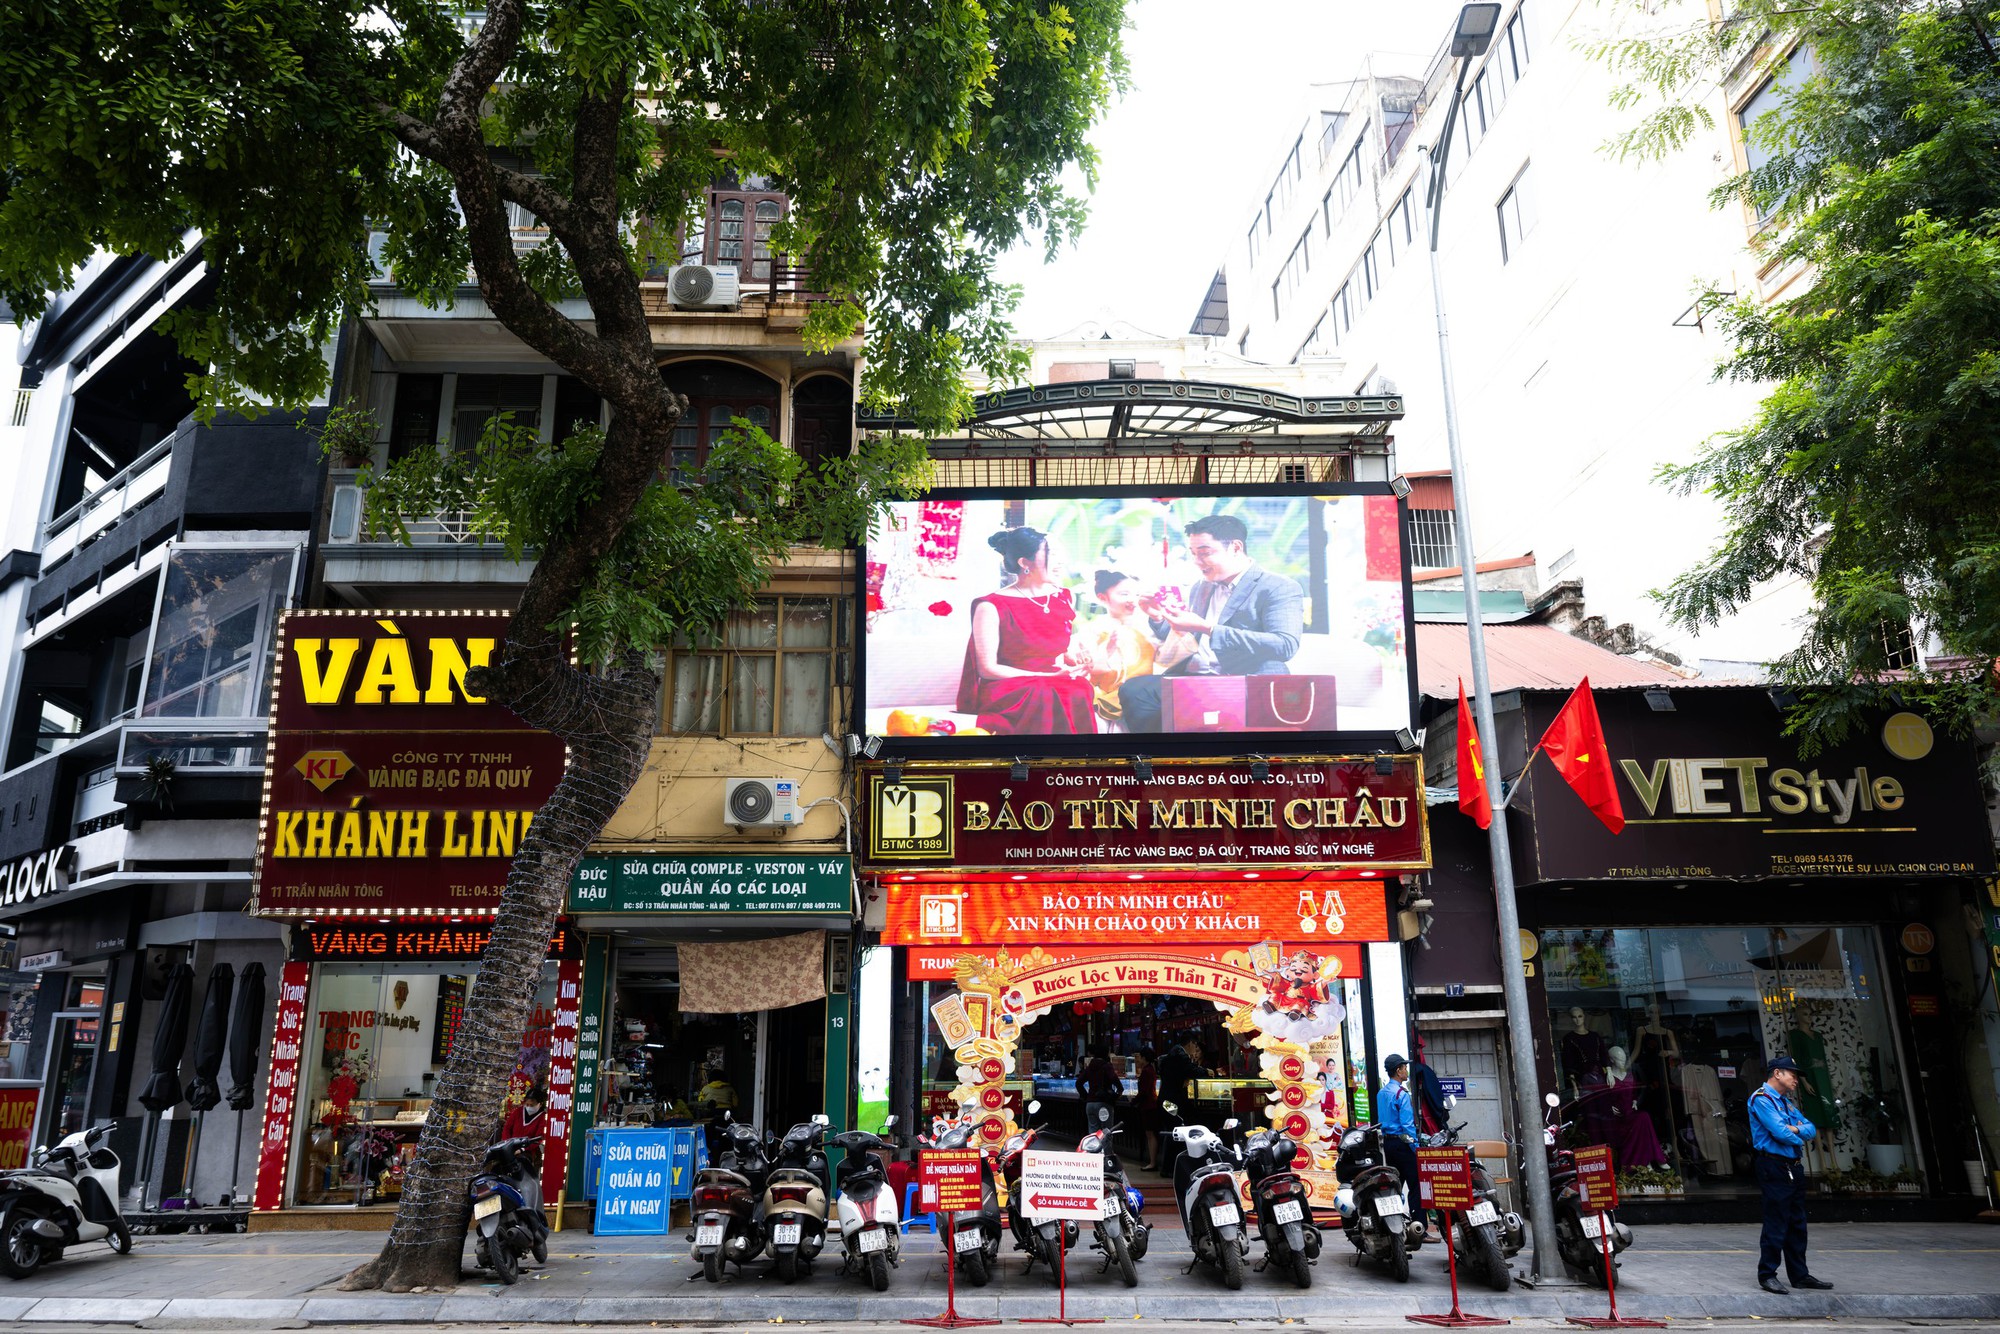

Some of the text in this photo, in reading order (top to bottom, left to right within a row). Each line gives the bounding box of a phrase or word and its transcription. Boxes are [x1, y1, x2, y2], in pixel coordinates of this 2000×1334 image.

[293, 620, 495, 704] VÀN
[391, 750, 512, 764] CÔNG TY TNHH
[303, 759, 344, 780] KL
[368, 765, 532, 792] VÀNG BẠC ĐÁ QUÝ
[1046, 771, 1325, 788] CÔNG TY TNHH BẠC ĐÁ LTD)
[963, 786, 1409, 832] BẢO TÍN MINH CHÂU
[272, 795, 430, 858] KHÁNH
[881, 839, 943, 850] BTMC 1989
[1005, 841, 1375, 858] KINH DOANH CHẾ TÁC VÀNG ĐÁ TRANG SỨC MỸ NGHỆ
[1771, 853, 1853, 864] TEL: 0969 543 376
[579, 867, 607, 881] ĐỨC
[623, 860, 843, 875] SỬA CHỮA COMPLE VESTON VÁY
[1607, 868, 1617, 876] 17
[1651, 865, 1680, 876] NHÂN
[1683, 865, 1712, 876] TÔNG
[1857, 861, 1974, 874] SỰ LỰA CHỌN CHO BẠN
[271, 882, 383, 898] 11 TRẦN NHÂN TÔNG
[450, 885, 473, 897] TEL:
[578, 886, 607, 902] HẬU
[660, 877, 807, 897] QUẦN ÁO CÁC LOẠI
[670, 901, 688, 910] NHÂN
[709, 901, 718, 910] HÀ
[1042, 891, 1224, 910] BẢO TÍN MINH CHÂU
[1007, 912, 1260, 933] XIN KÍNH CHÀO QUÝ KHÁCH
[311, 929, 491, 954] VÀNG KHÁNH
[561, 980, 576, 998] Kim
[1032, 965, 1238, 996] Rước Lộc Vàng Thần Tài
[283, 982, 305, 1003] Trang
[282, 1007, 298, 1029] Sức
[319, 1010, 374, 1028] TRANG
[585, 1013, 598, 1026] SỬA
[831, 1018, 844, 1028] 13
[325, 1030, 360, 1050] SỨC
[581, 1030, 598, 1042] CHỮA
[275, 1035, 296, 1060] Nhẫn
[583, 1066, 592, 1077] ÁO
[1283, 1065, 1300, 1073] Sang
[273, 1068, 292, 1088] Cưới
[579, 1082, 592, 1093] CÁC
[272, 1093, 288, 1114] Cao
[549, 1091, 570, 1112] Phong
[577, 1102, 592, 1114] LOẠI
[268, 1117, 285, 1143] Cấp
[1291, 1121, 1301, 1129] An
[608, 1142, 666, 1160] SỬA CHỮA
[609, 1168, 642, 1189] QUẦN
[645, 1170, 661, 1188] ÁO
[1044, 1181, 1061, 1189] RỒNG
[605, 1195, 661, 1215] LẤY NGAY
[777, 1234, 797, 1243] 3030
